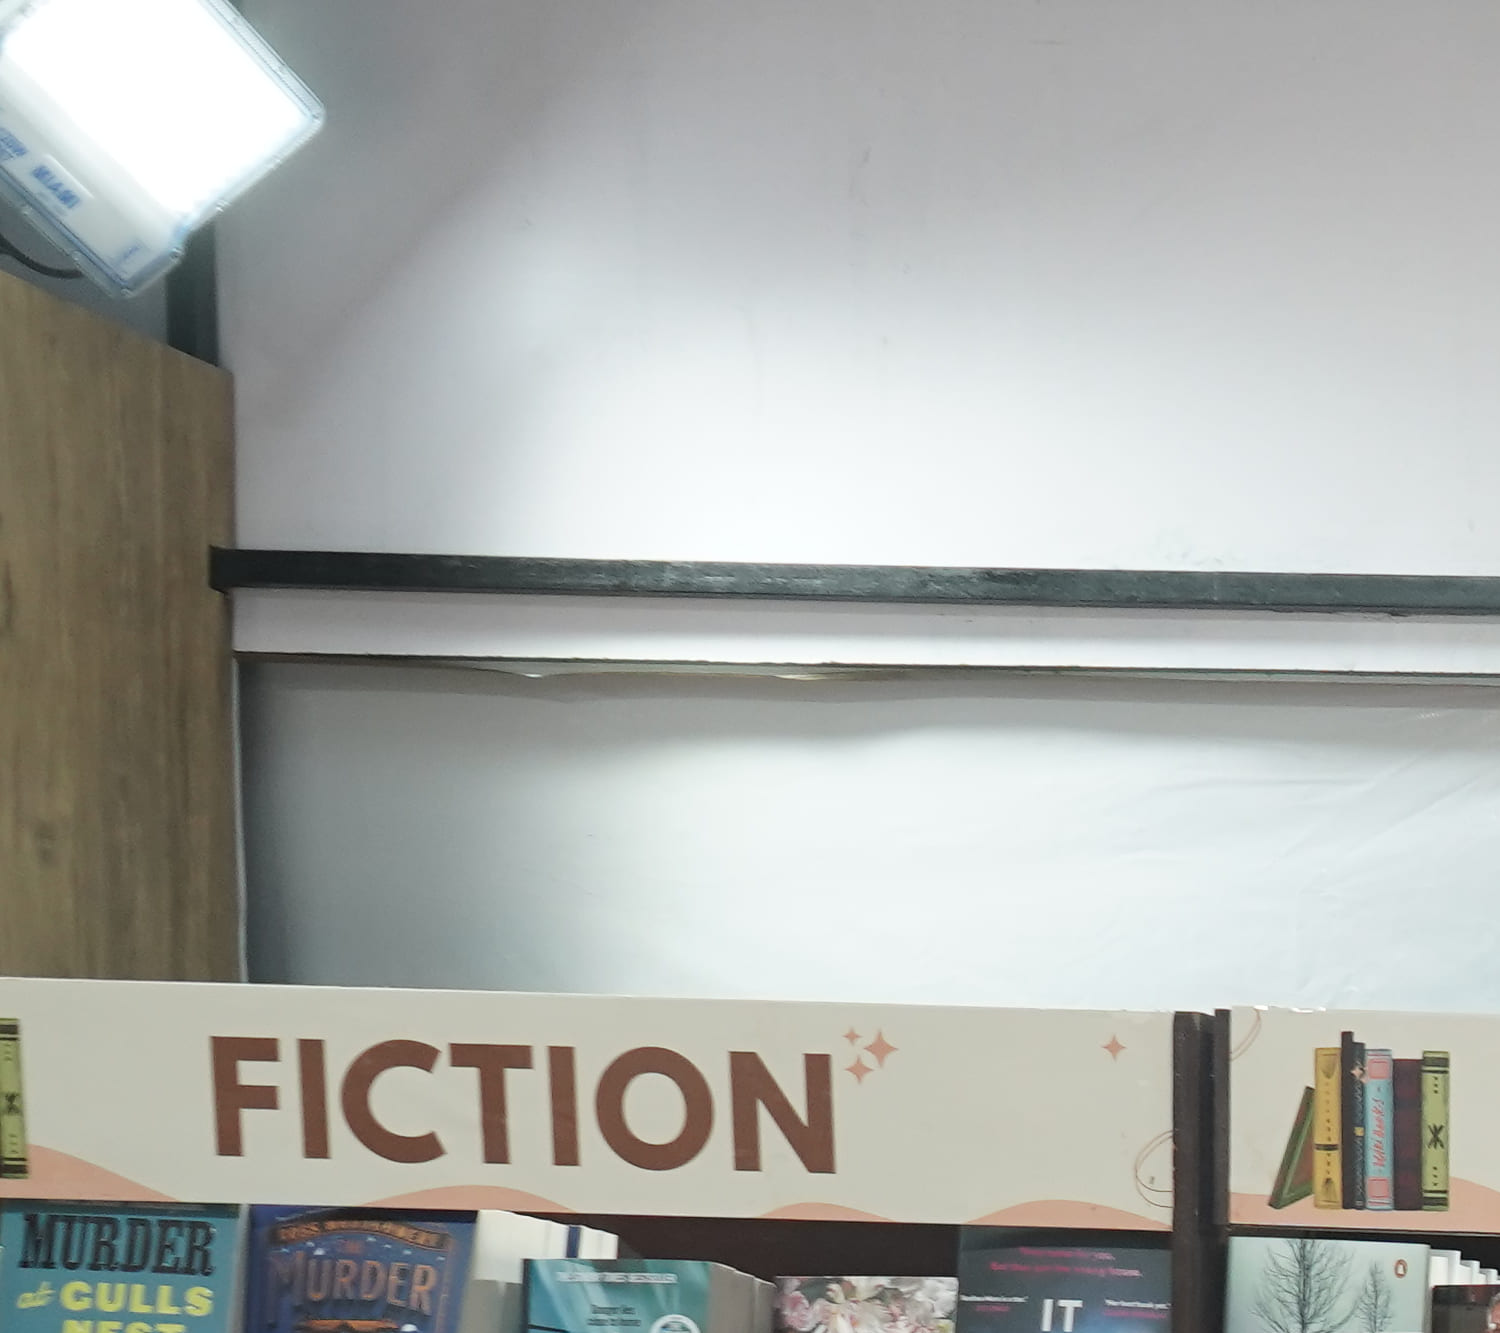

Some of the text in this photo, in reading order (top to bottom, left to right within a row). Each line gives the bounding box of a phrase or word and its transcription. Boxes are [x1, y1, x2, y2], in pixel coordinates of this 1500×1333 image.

[208, 1034, 836, 1175] FICTION
[18, 1212, 218, 1277] MURDER
[18, 1280, 214, 1317] at GULLS
[1040, 1299, 1082, 1333] IT
